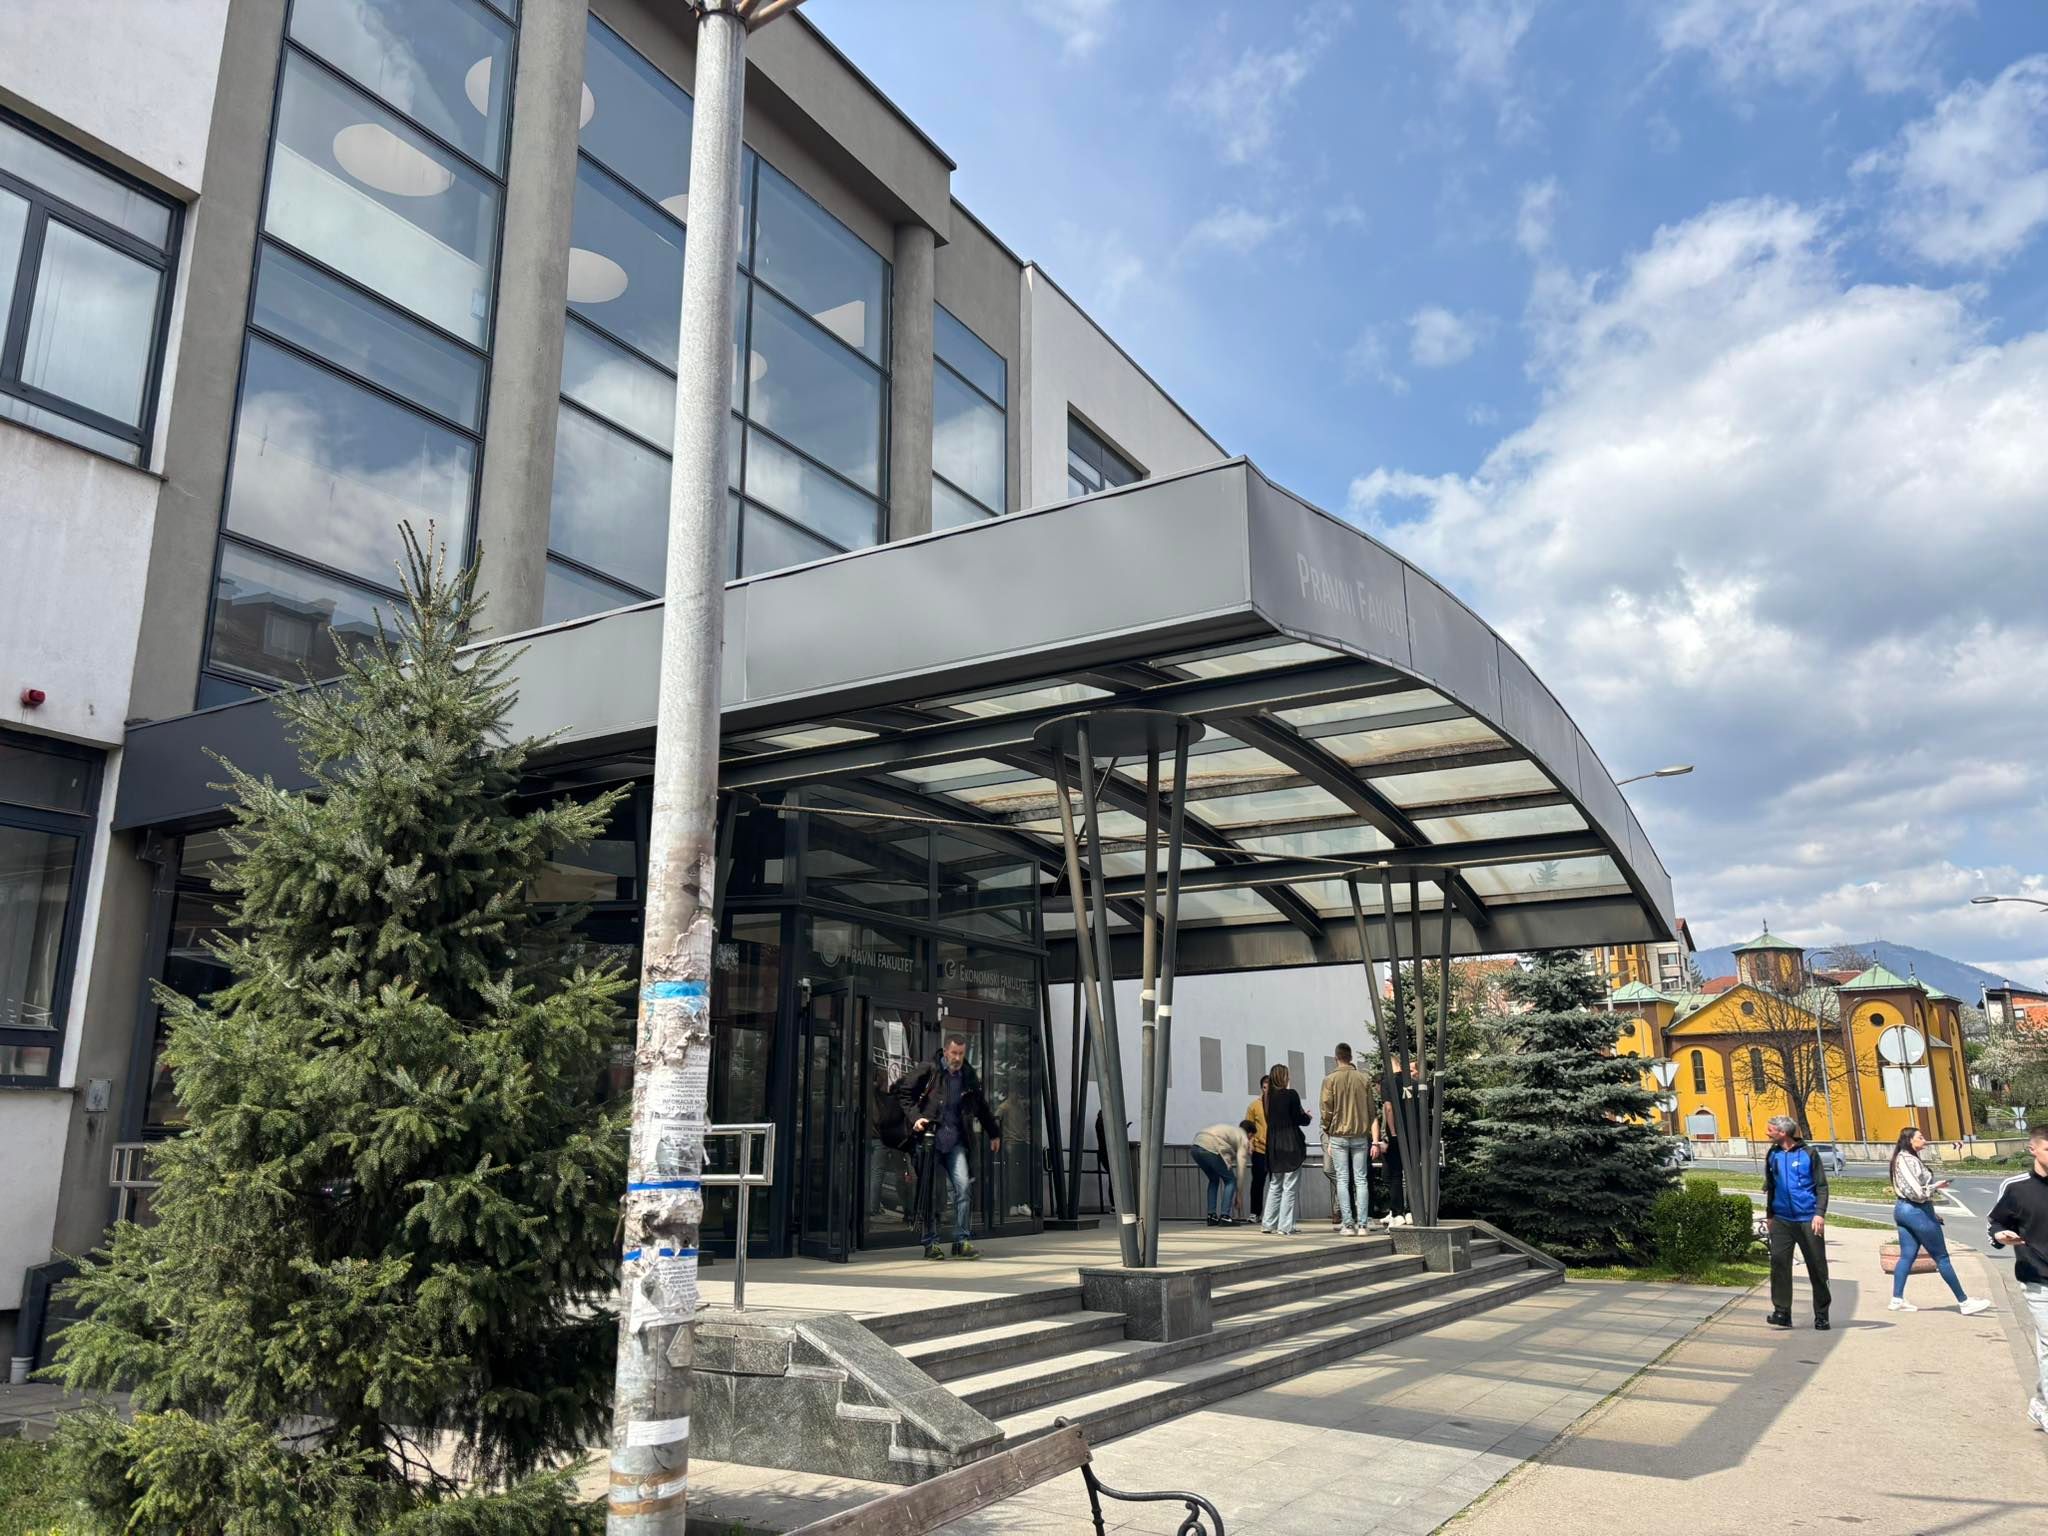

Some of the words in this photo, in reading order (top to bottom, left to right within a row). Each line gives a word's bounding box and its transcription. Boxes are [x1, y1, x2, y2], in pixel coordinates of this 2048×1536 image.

[1296, 552, 1356, 616] PRAVNI
[844, 944, 876, 967] PRAVNI
[877, 952, 914, 973] FAKULTET
[960, 964, 999, 986] EKONOMSKI
